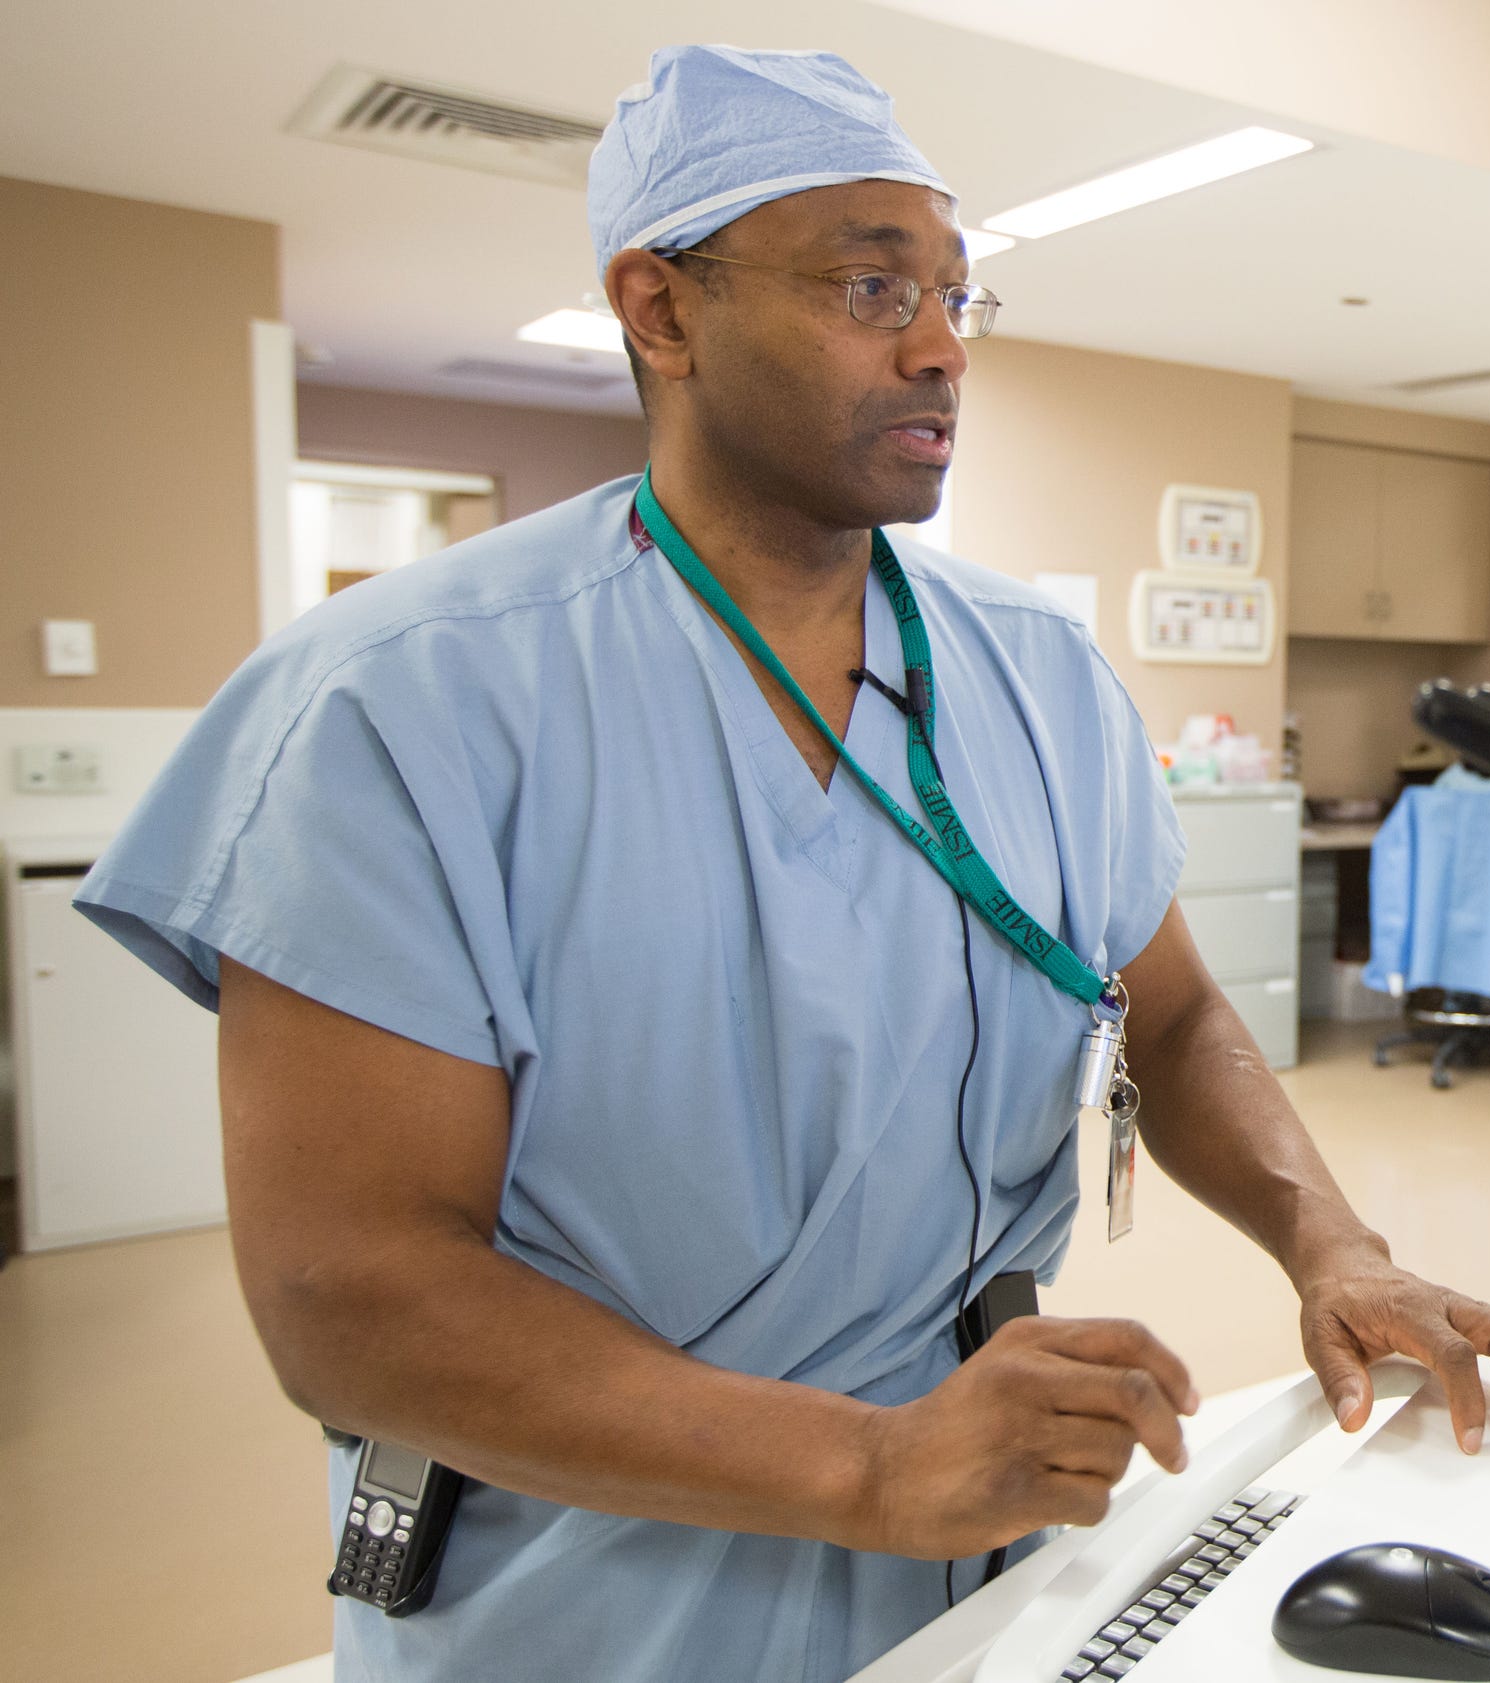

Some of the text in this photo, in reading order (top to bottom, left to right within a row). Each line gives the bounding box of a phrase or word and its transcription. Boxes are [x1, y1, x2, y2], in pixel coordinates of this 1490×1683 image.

[876, 545, 921, 623] ISMIE
[918, 783, 976, 861] ISMIE
[985, 890, 1056, 960] ISMIE
